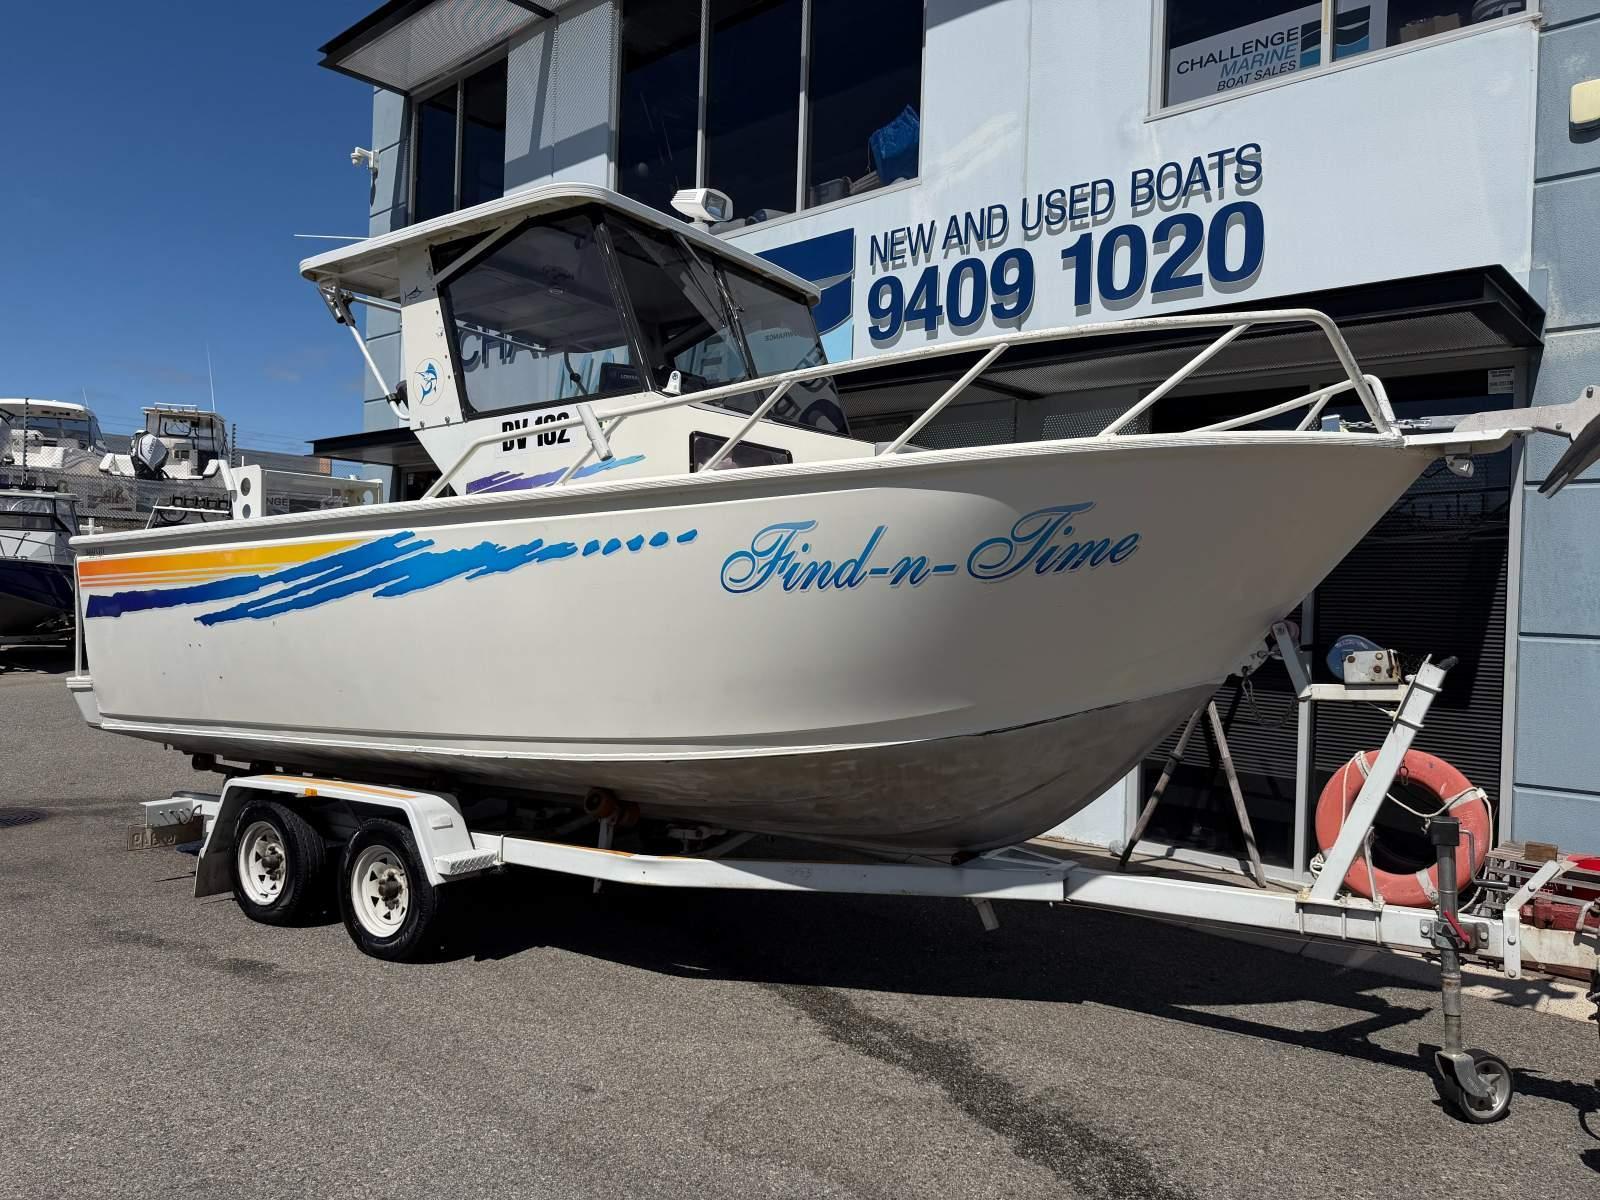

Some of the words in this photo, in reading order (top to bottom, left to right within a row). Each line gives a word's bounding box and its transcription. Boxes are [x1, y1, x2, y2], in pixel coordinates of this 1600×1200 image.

[1177, 27, 1299, 74] CHALLENGE
[1220, 43, 1297, 78] MARINE
[1217, 73, 1252, 91] BOAT
[1254, 60, 1297, 80] SALES
[870, 220, 935, 267] NEW
[942, 204, 1008, 249] AND
[1021, 178, 1115, 231] USED
[1130, 143, 1263, 207] BOATS
[868, 247, 1035, 341] 9409
[1061, 201, 1265, 306] 1020
[502, 418, 528, 452] DV
[535, 412, 570, 446] 102
